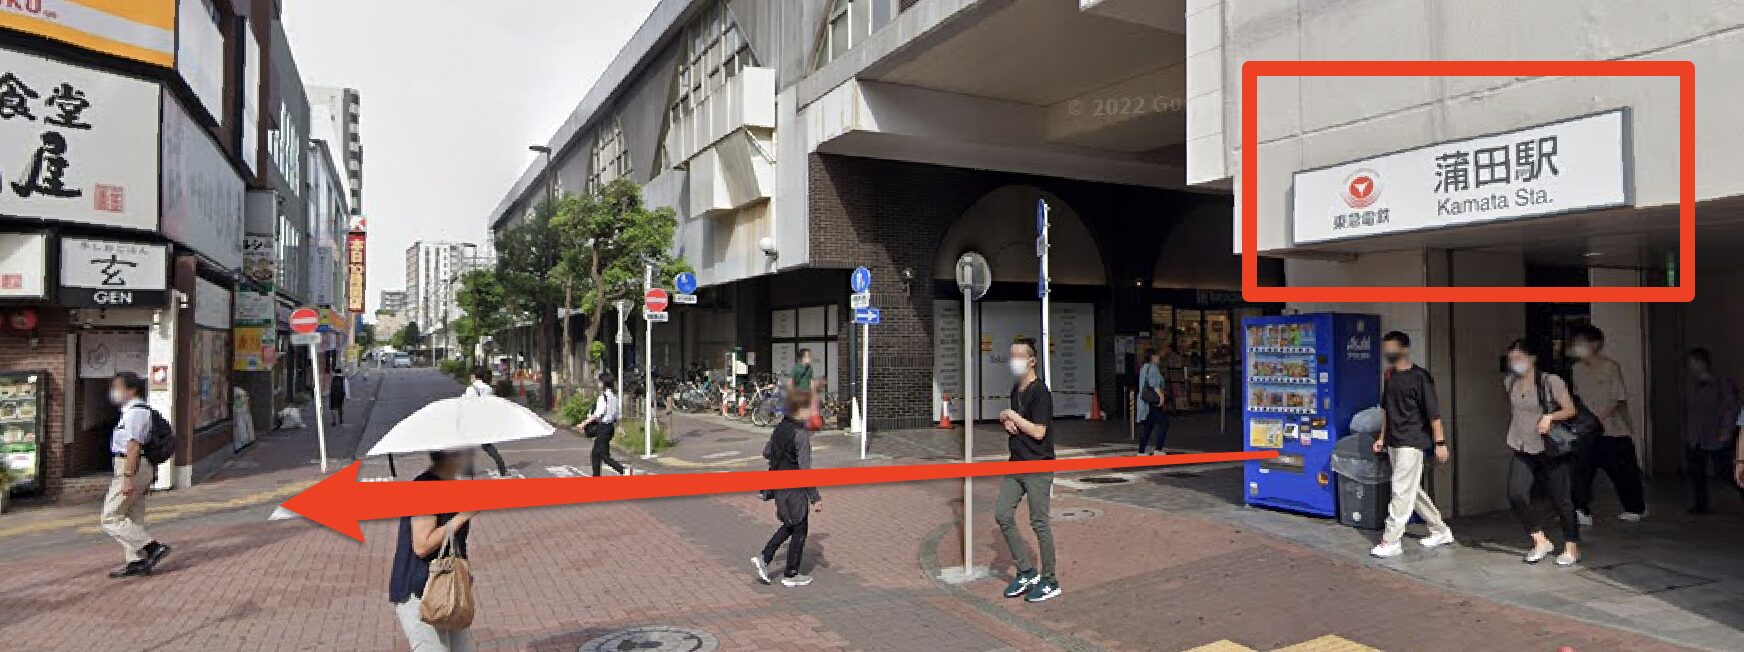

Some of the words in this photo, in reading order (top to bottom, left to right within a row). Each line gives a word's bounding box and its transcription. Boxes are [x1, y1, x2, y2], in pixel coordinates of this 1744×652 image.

[0, 71, 92, 130] 食堂
[10, 131, 82, 197] 屋
[1434, 135, 1560, 194] 蒲田駅
[1437, 193, 1510, 216] Kamata
[1514, 188, 1554, 207] Sta.
[1332, 207, 1391, 231] 東急電鉄
[90, 254, 138, 286] 玄
[93, 291, 134, 305] GEN
